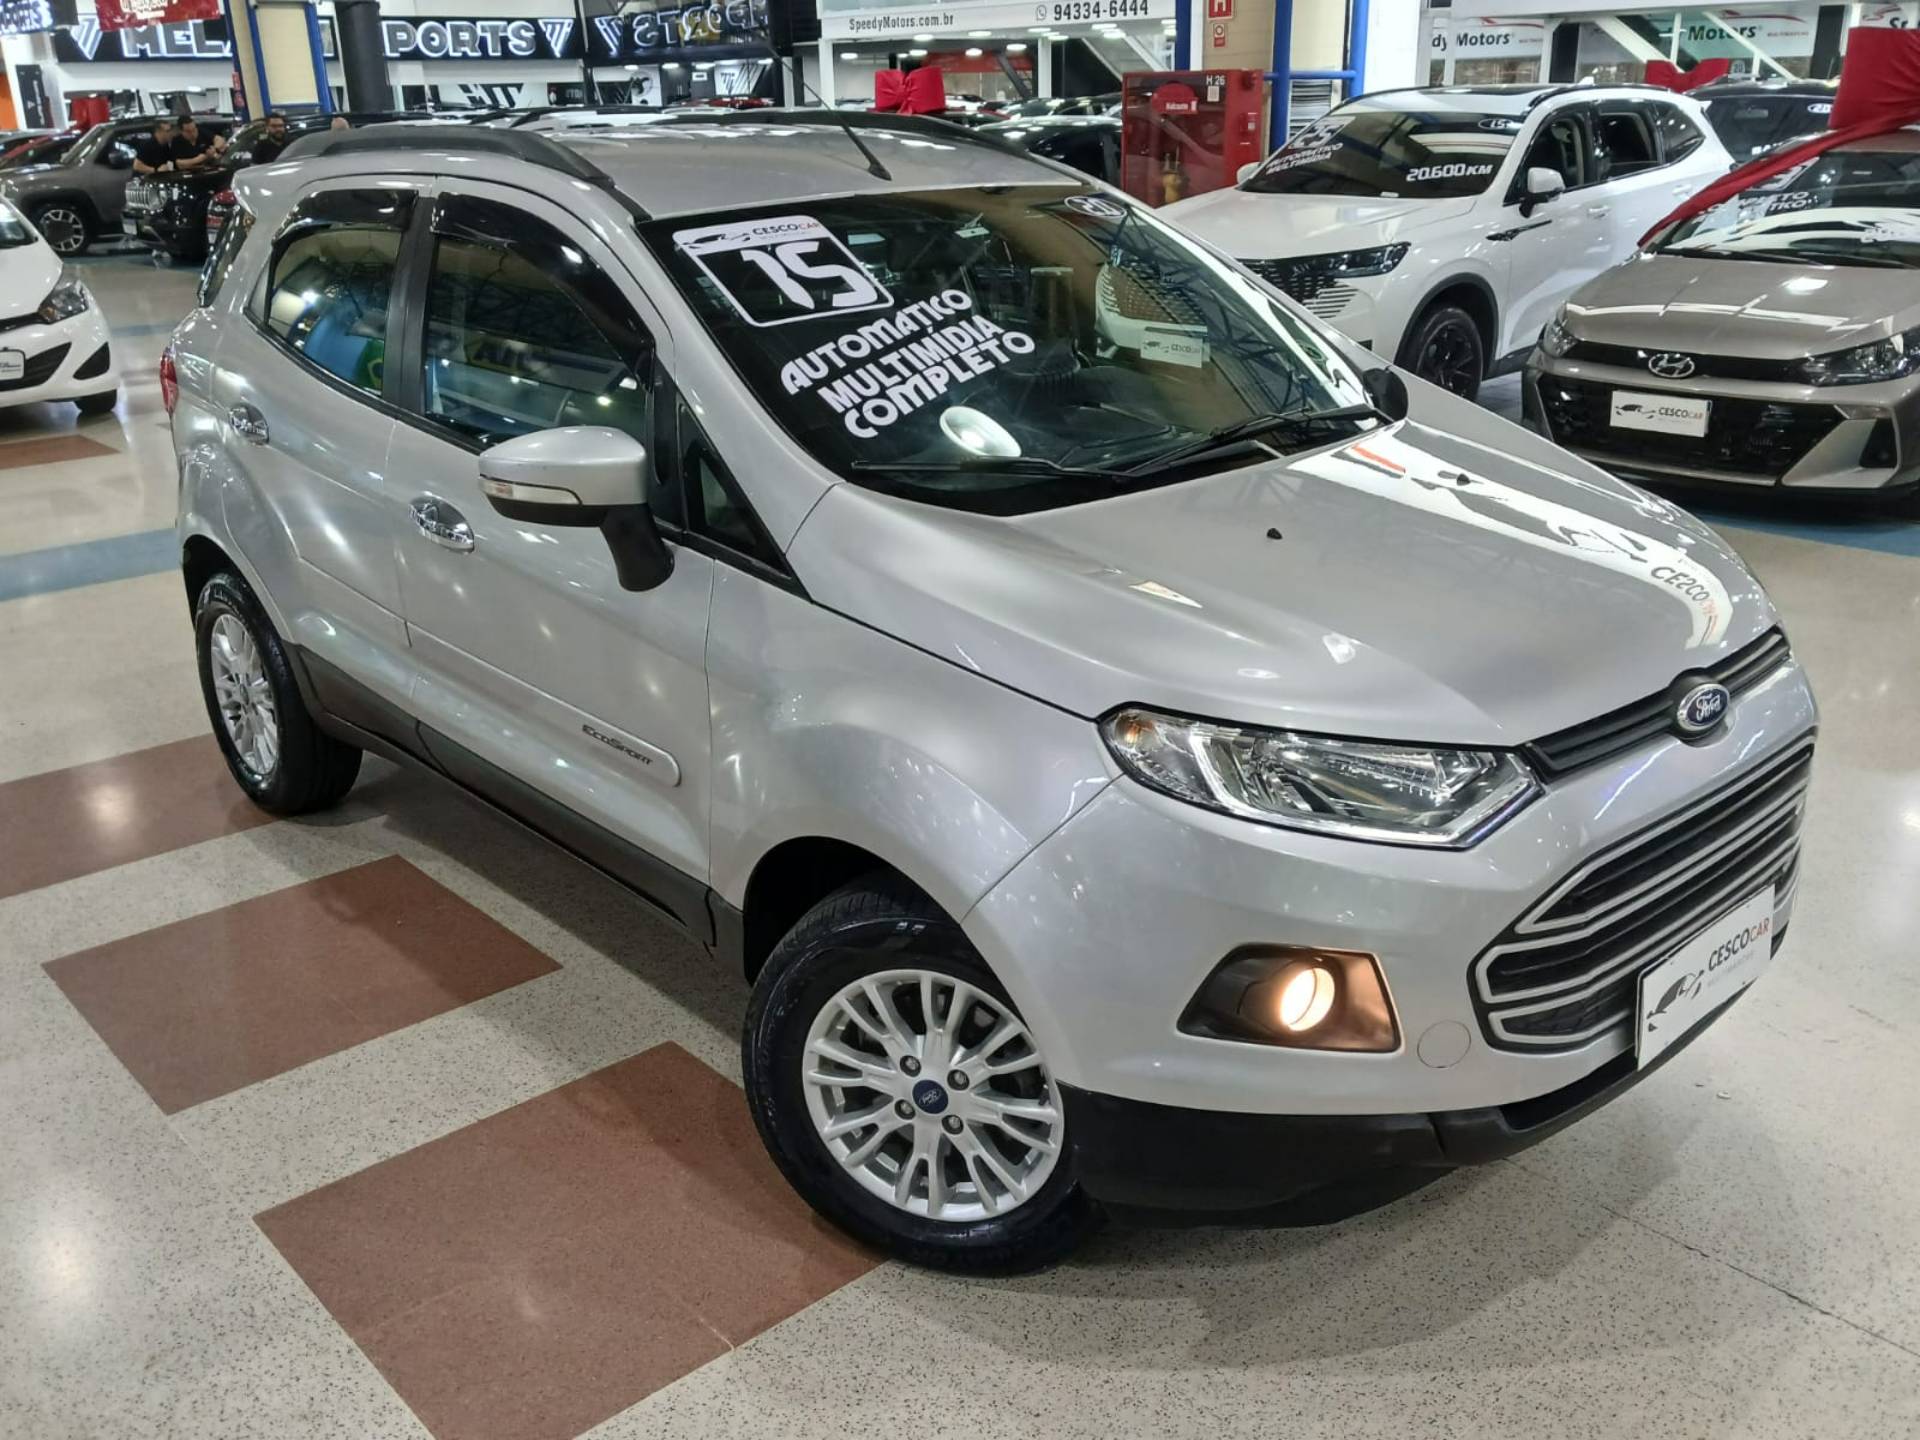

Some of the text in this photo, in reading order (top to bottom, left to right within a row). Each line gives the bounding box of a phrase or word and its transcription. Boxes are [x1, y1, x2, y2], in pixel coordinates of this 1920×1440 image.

[849, 14, 954, 31] SpeedyMotors.com.br
[1054, 0, 1149, 21] 94334-6444
[844, 331, 1035, 438] COMPLETO
[1708, 917, 1769, 972] CESCOCAR
